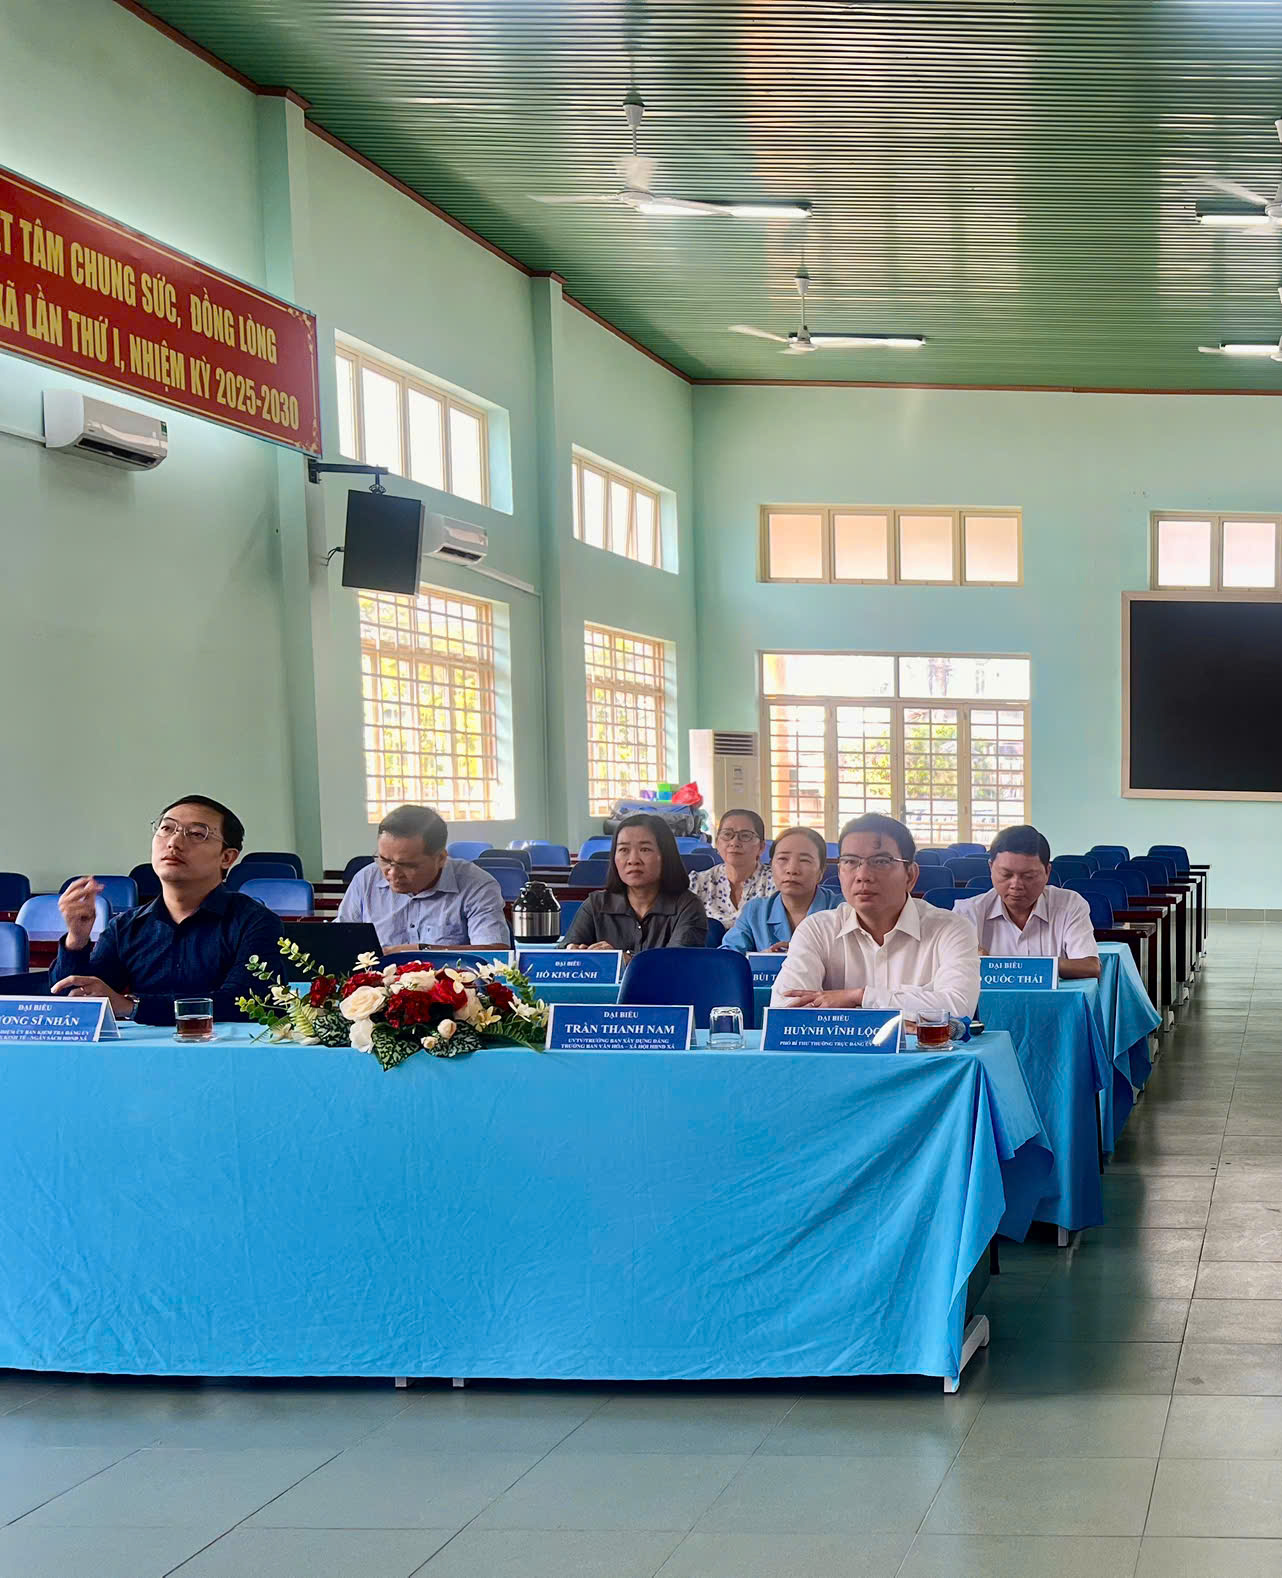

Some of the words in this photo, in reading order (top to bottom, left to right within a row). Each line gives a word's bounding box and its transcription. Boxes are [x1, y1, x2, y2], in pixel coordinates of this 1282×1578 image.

[0, 209, 13, 255] T
[20, 218, 64, 277] TÂM
[71, 242, 136, 307] CHUNG
[141, 271, 181, 329] SỨC,
[190, 288, 235, 348] ĐỒNG
[239, 314, 277, 364] LÒNG
[25, 284, 63, 347] LẦN
[68, 310, 108, 363] THỨ
[130, 333, 185, 392] NHIỆM
[190, 355, 211, 400] KỲ
[216, 367, 299, 431] 2025-2030
[988, 962, 1003, 970] ĐẠI
[551, 971, 570, 979] KIM
[1017, 974, 1044, 984] THÁI
[604, 1012, 619, 1020] ĐẠI
[601, 1024, 645, 1034] THANH
[646, 1025, 676, 1034] NAM
[783, 1024, 824, 1035] HUỲNH
[827, 1025, 855, 1036] VĨNH
